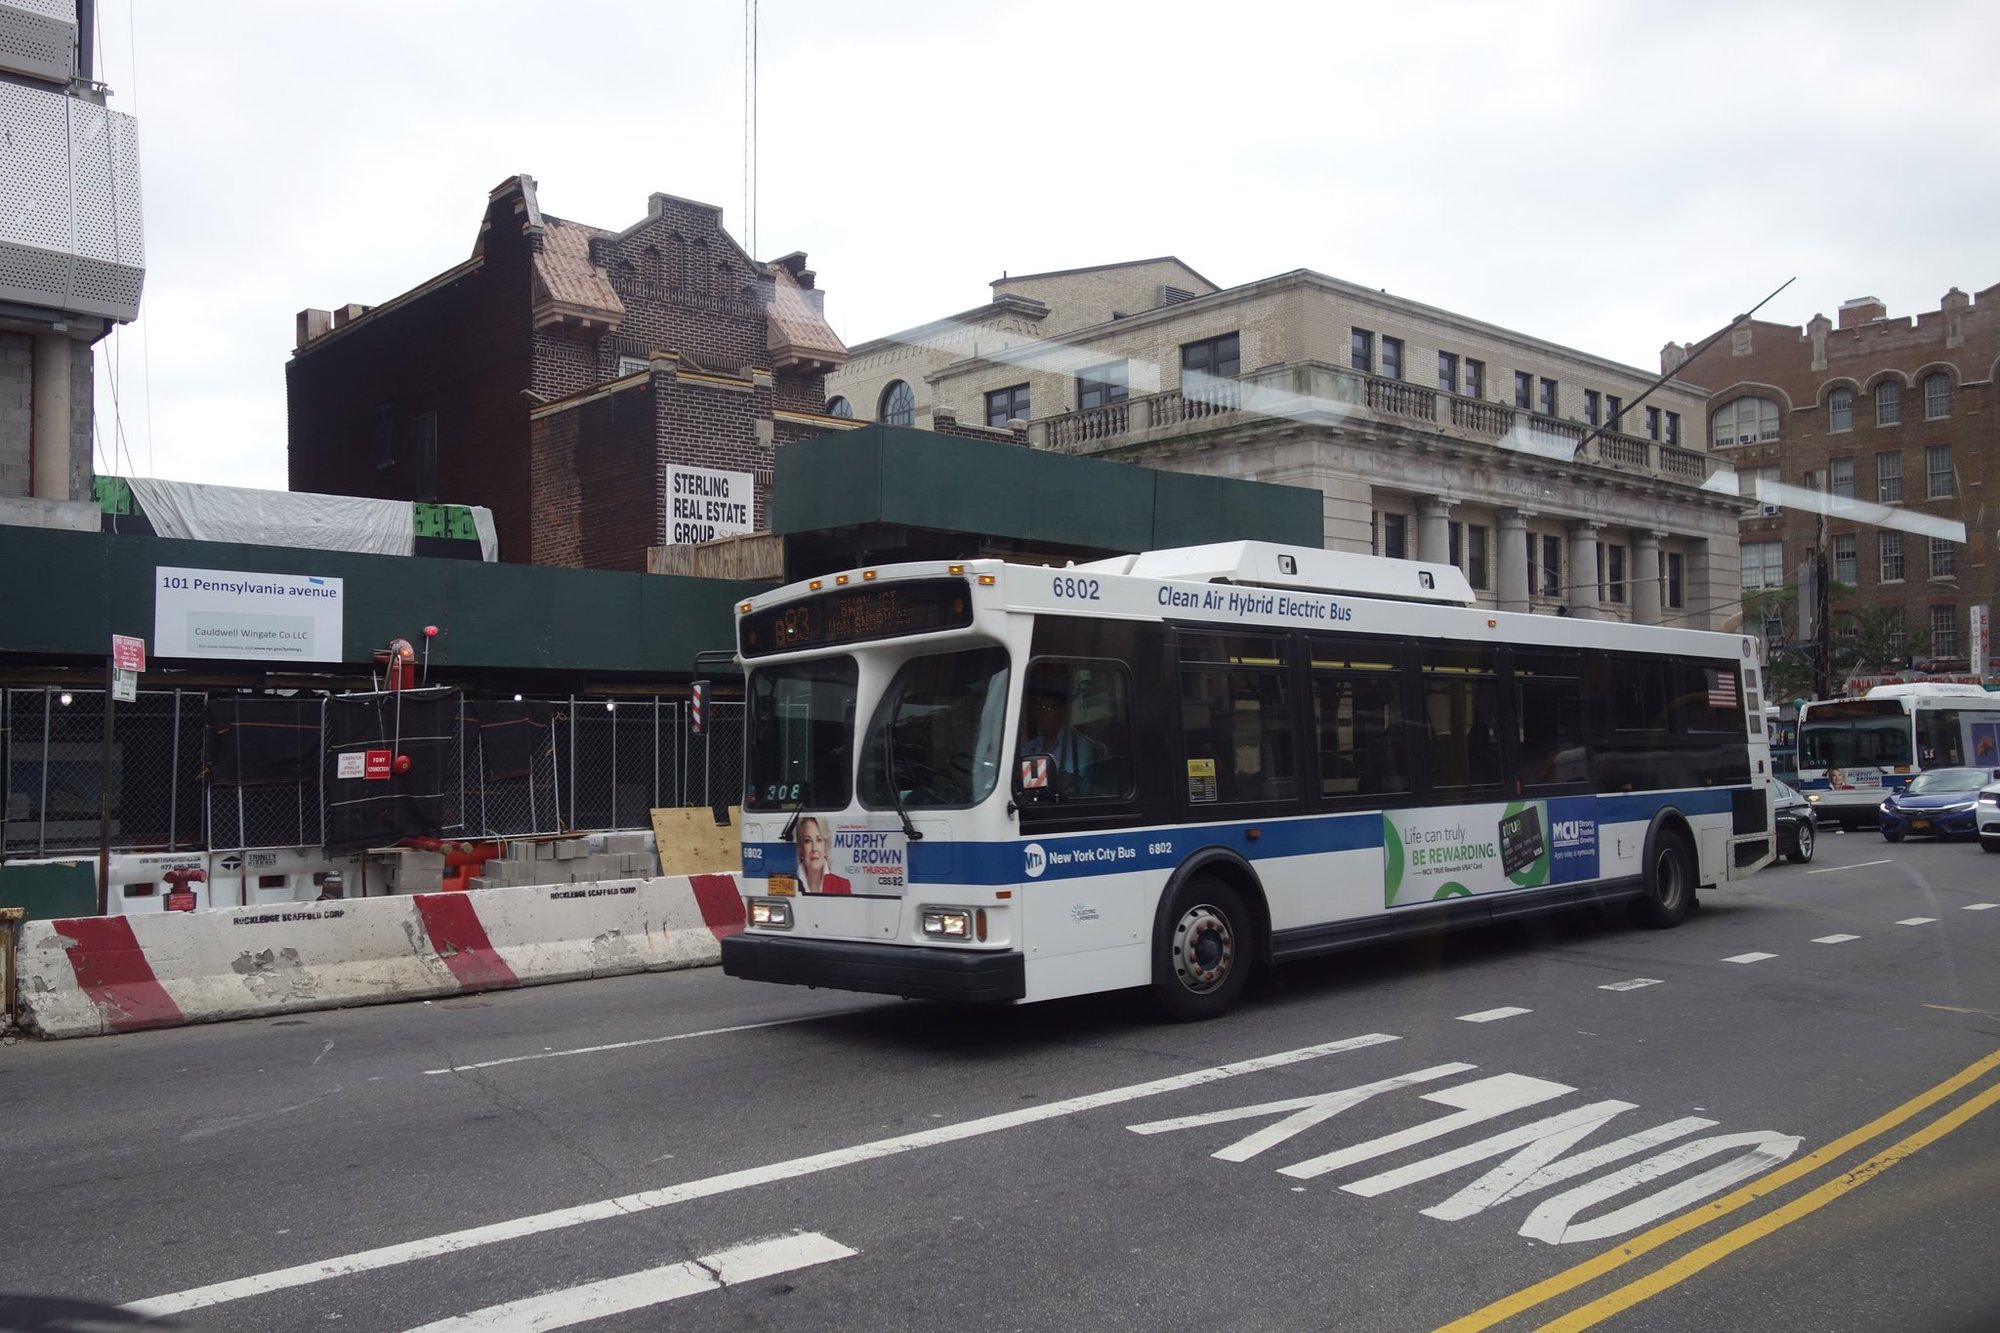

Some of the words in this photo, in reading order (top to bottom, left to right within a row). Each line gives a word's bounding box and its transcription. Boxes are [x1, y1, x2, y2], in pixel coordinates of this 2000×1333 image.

[674, 472, 729, 498] STERLING
[674, 498, 702, 520] REAL
[706, 501, 746, 524] ESTATE
[674, 522, 714, 544] GROUP
[163, 577, 188, 589] 101
[194, 578, 284, 595] Pennsylvania
[289, 587, 336, 598] avenue
[1053, 576, 1100, 600] 6802
[1158, 586, 1198, 608] Clean
[1203, 590, 1224, 611] Air
[1228, 592, 1274, 616] Hybrid
[1278, 597, 1326, 619] Electric
[1330, 603, 1352, 621] Bus
[195, 627, 239, 637] Cauldwell
[241, 628, 278, 640] Wingate
[279, 631, 291, 639] Co
[292, 631, 308, 640] LLC
[768, 784, 800, 800] 308
[1404, 826, 1421, 844] Life
[1425, 830, 1442, 842] can
[1444, 823, 1465, 844] truly
[1553, 820, 1579, 840] MCU
[834, 834, 888, 848] MURPHY
[1149, 842, 1172, 855] 6802
[744, 848, 762, 859] 6802
[853, 850, 902, 863] BROWN
[1024, 852, 1042, 869] MTA
[1050, 852, 1071, 864] New
[1073, 850, 1095, 862] York
[1096, 848, 1116, 862] City
[1118, 847, 1136, 858] Bus
[1412, 849, 1426, 866] BE
[1429, 843, 1496, 864] REWARDING.
[862, 866, 903, 874] THURSDAYS
[550, 890, 586, 899] ROCKLEDGE
[588, 888, 618, 897] SCAFFOLD
[233, 914, 280, 925] ROCKLEDGE
[282, 912, 321, 921] SCAFFOLD
[324, 911, 345, 919] CORP
[1126, 1061, 1806, 1246] ONLY
